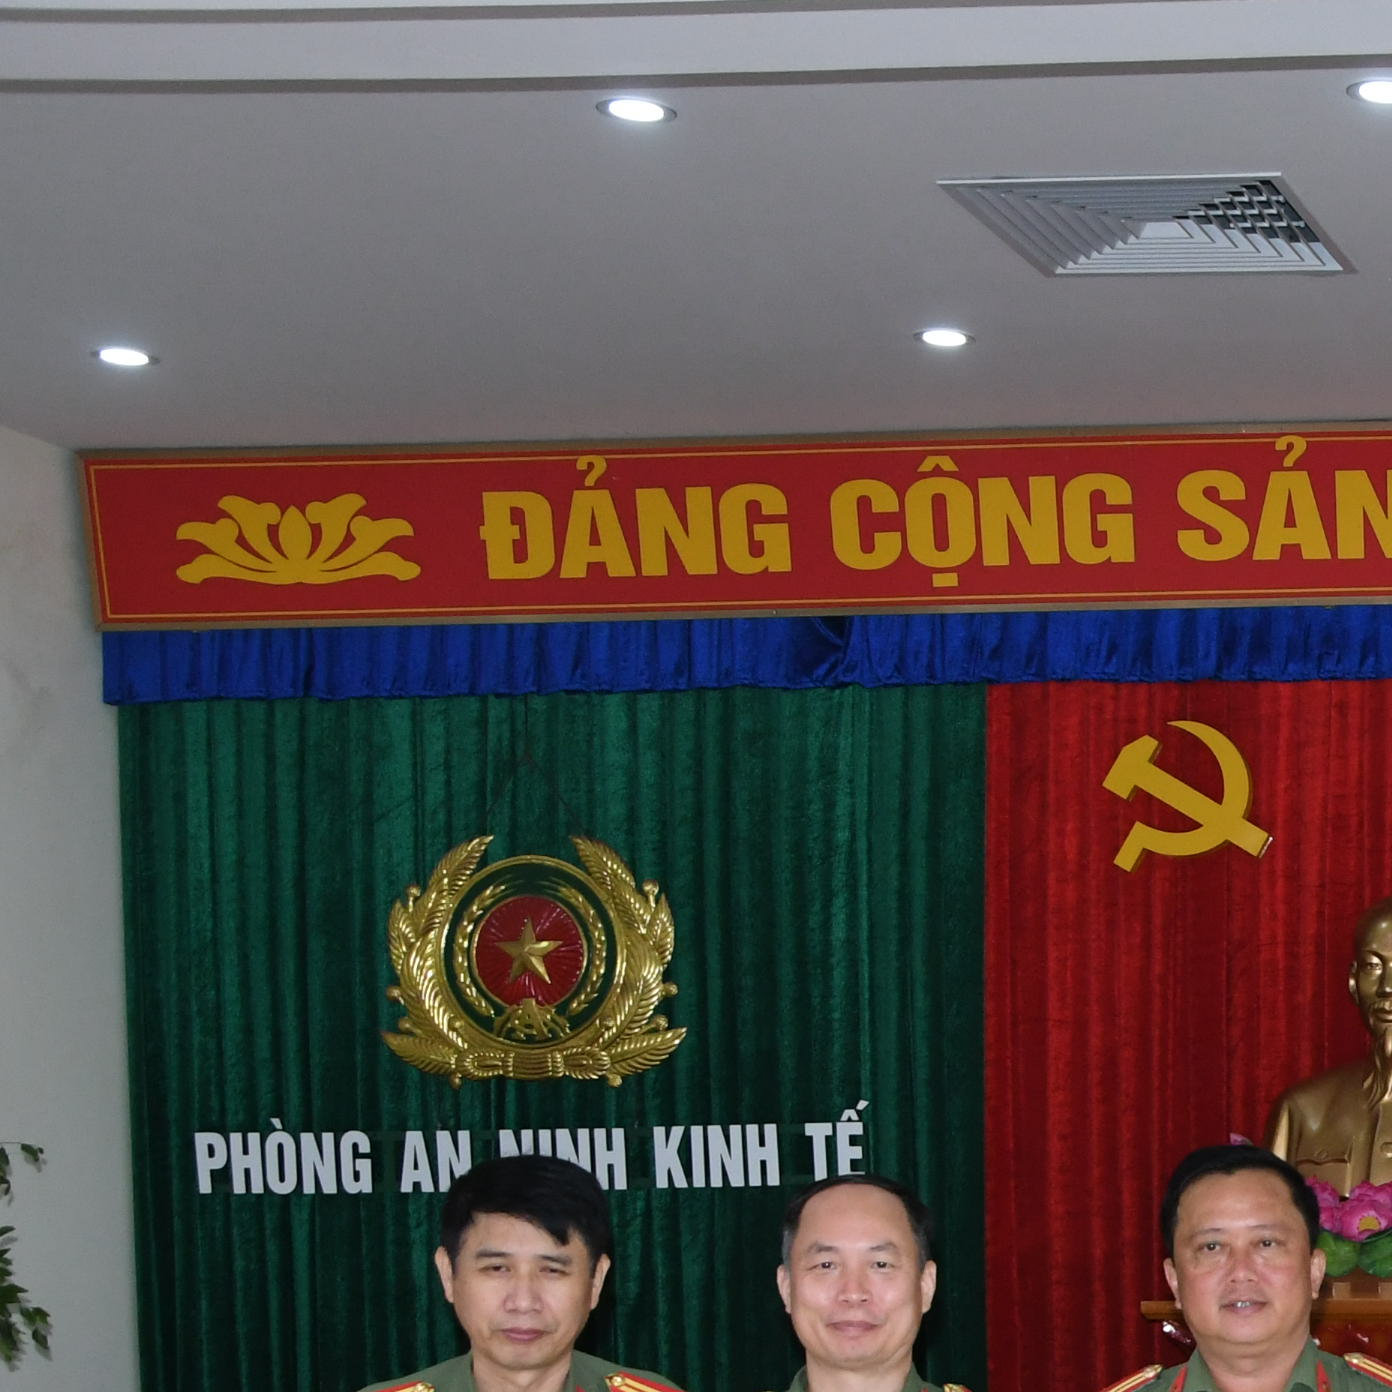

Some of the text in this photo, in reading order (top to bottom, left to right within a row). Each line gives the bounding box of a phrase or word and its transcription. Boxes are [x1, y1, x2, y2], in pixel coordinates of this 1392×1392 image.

[480, 456, 792, 580] ĐẢNG
[831, 456, 1136, 587] CỘNG
[195, 1118, 373, 1195] PHÒNG
[400, 1130, 472, 1193] AN
[653, 1125, 780, 1189] KINH
[804, 1100, 869, 1183] TẾ
